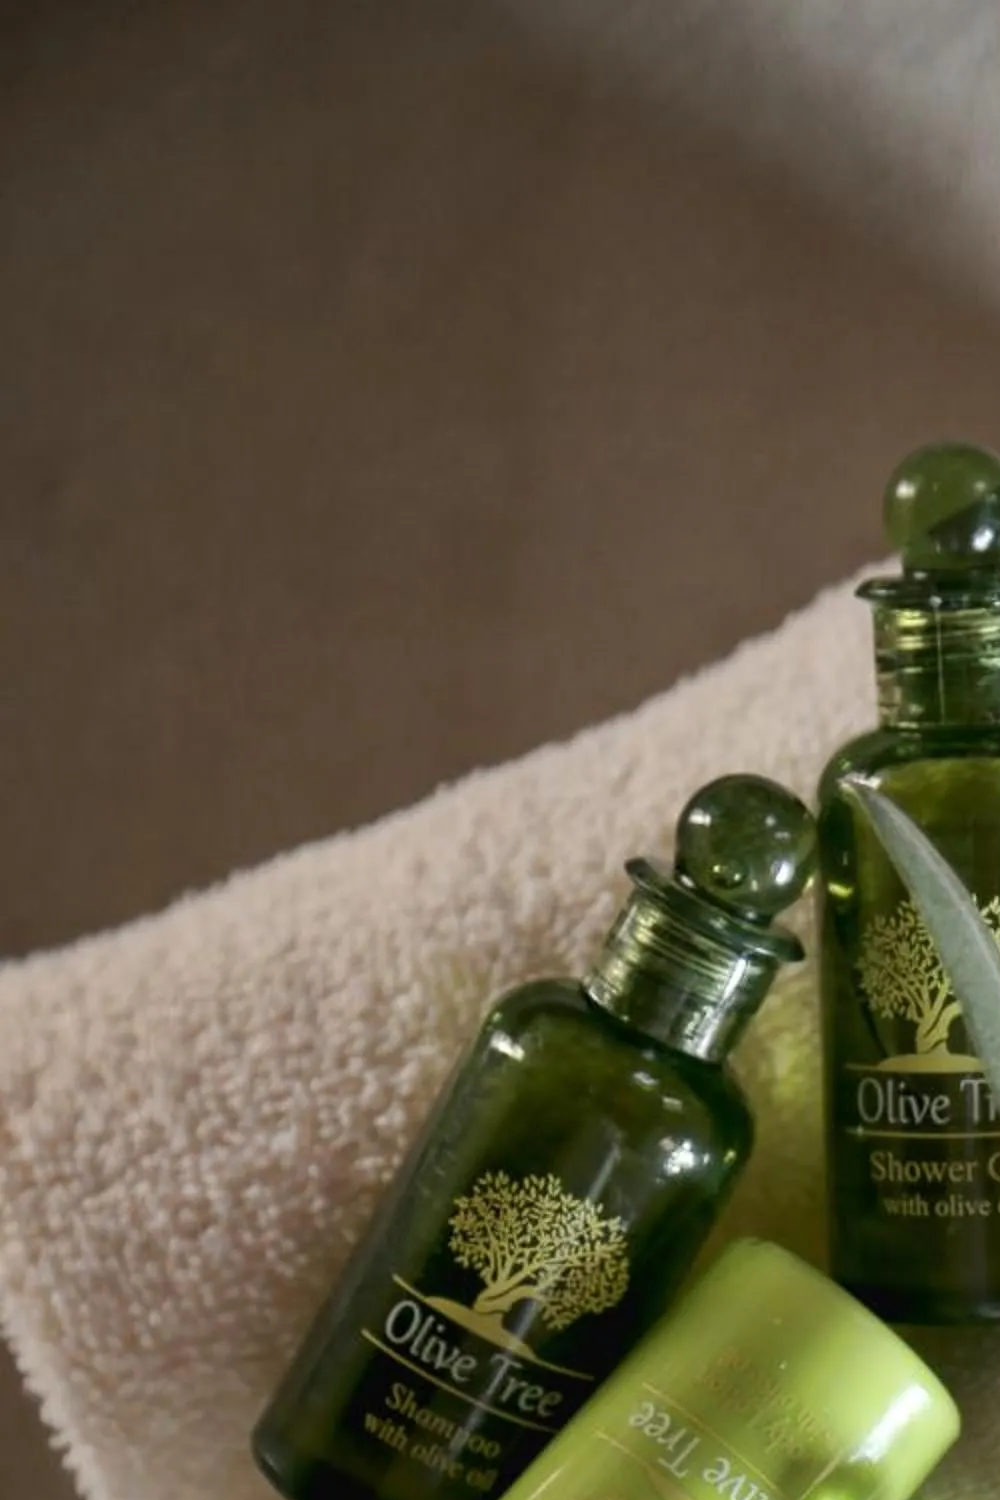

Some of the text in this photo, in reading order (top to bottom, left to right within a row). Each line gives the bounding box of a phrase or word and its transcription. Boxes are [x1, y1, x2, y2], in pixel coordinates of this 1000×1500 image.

[857, 1076, 951, 1125] Olive
[869, 1151, 978, 1183] Shower
[883, 1192, 930, 1217] with
[934, 1193, 992, 1218] olive
[384, 1299, 565, 1418] Olive Tree
[364, 1412, 408, 1451] with
[628, 1401, 701, 1479] Tree
